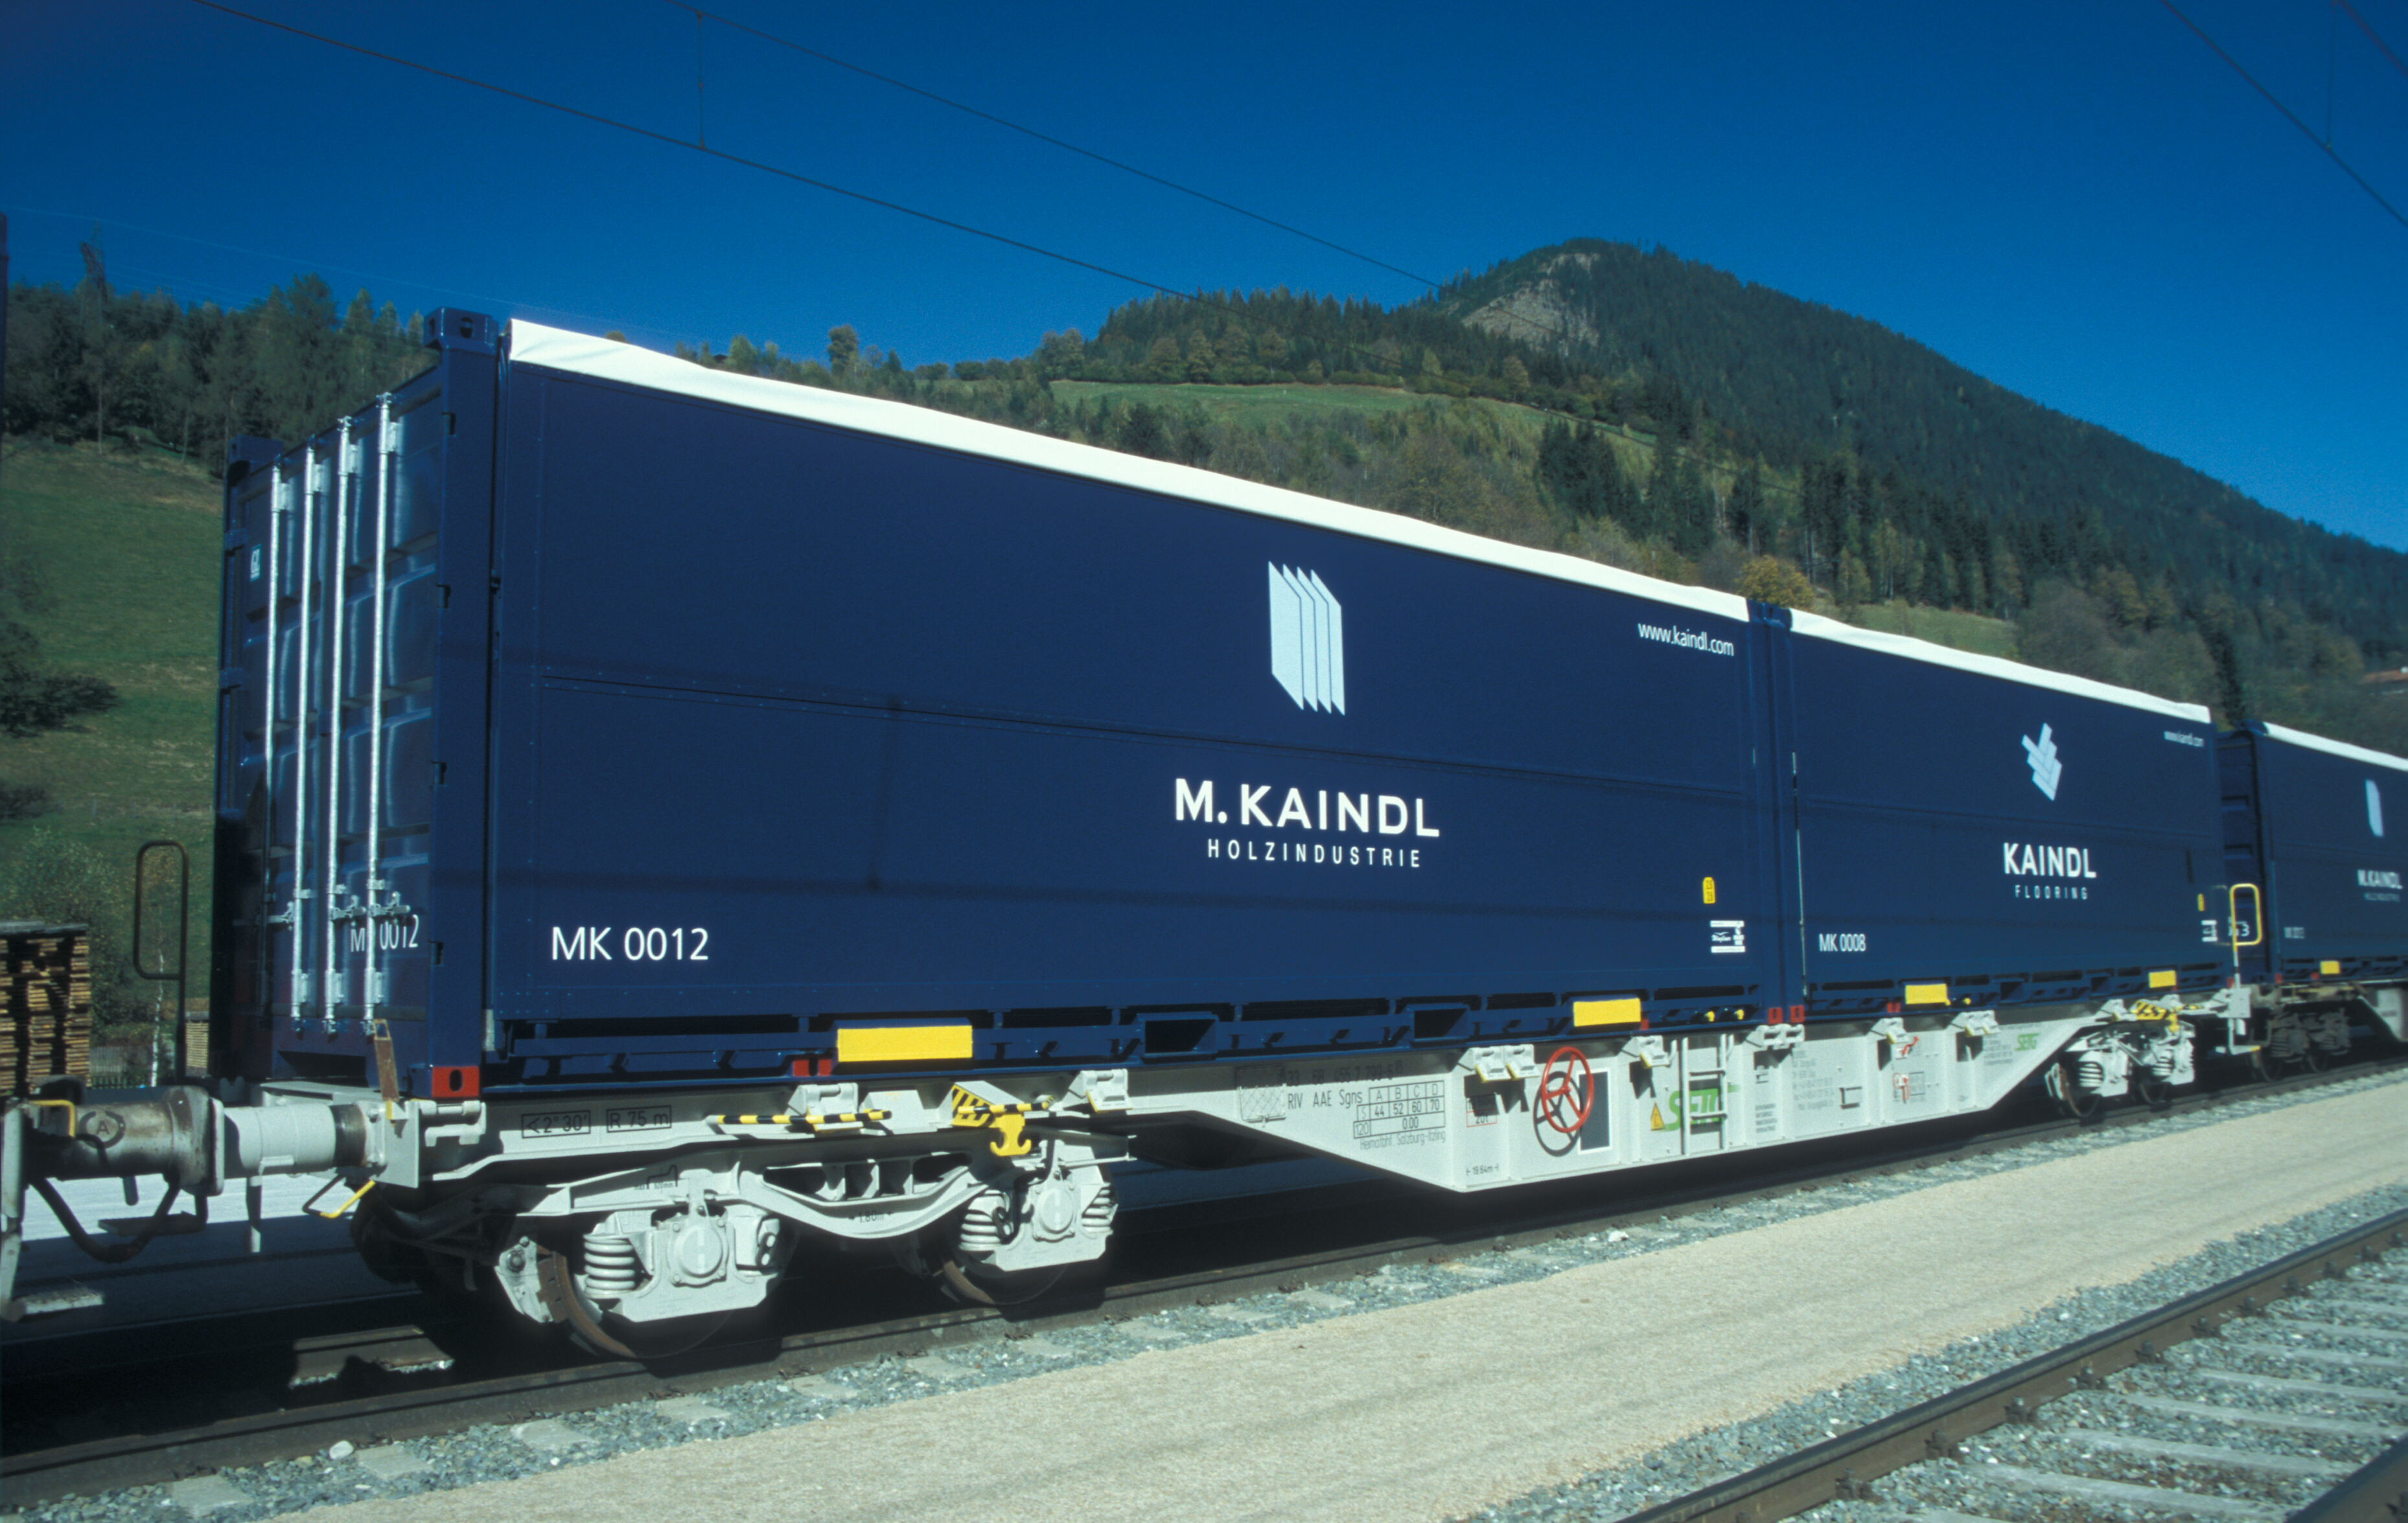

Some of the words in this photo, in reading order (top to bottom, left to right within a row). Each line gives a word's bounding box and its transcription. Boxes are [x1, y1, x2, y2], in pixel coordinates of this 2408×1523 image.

[1638, 623, 1735, 656] www.kaindl.com
[1208, 838, 1420, 867] HOLZINDUSTRIE
[2003, 842, 2096, 878] KAINDL
[2015, 884, 2088, 900] FLOORING
[552, 926, 612, 960] MK
[624, 927, 709, 960] 0012
[1819, 933, 1838, 952] MK
[1839, 933, 1866, 952] 0008
[1288, 1093, 1303, 1109] RIV
[1313, 1091, 1332, 1108] AAE
[1339, 1089, 1363, 1108] Sgns
[1375, 1090, 1383, 1101] A
[1395, 1087, 1402, 1099] B
[1413, 1086, 1420, 1097] C
[1431, 1083, 1439, 1095] D
[1374, 1105, 1385, 1117] 44
[1393, 1103, 1404, 1115] 52
[1412, 1101, 1422, 1113] 60
[1430, 1099, 1440, 1111] 70
[95, 1120, 110, 1135] A
[610, 1112, 621, 1128] R
[628, 1110, 647, 1127] 75
[653, 1112, 669, 1126] m
[1402, 1117, 1419, 1130] 0.00
